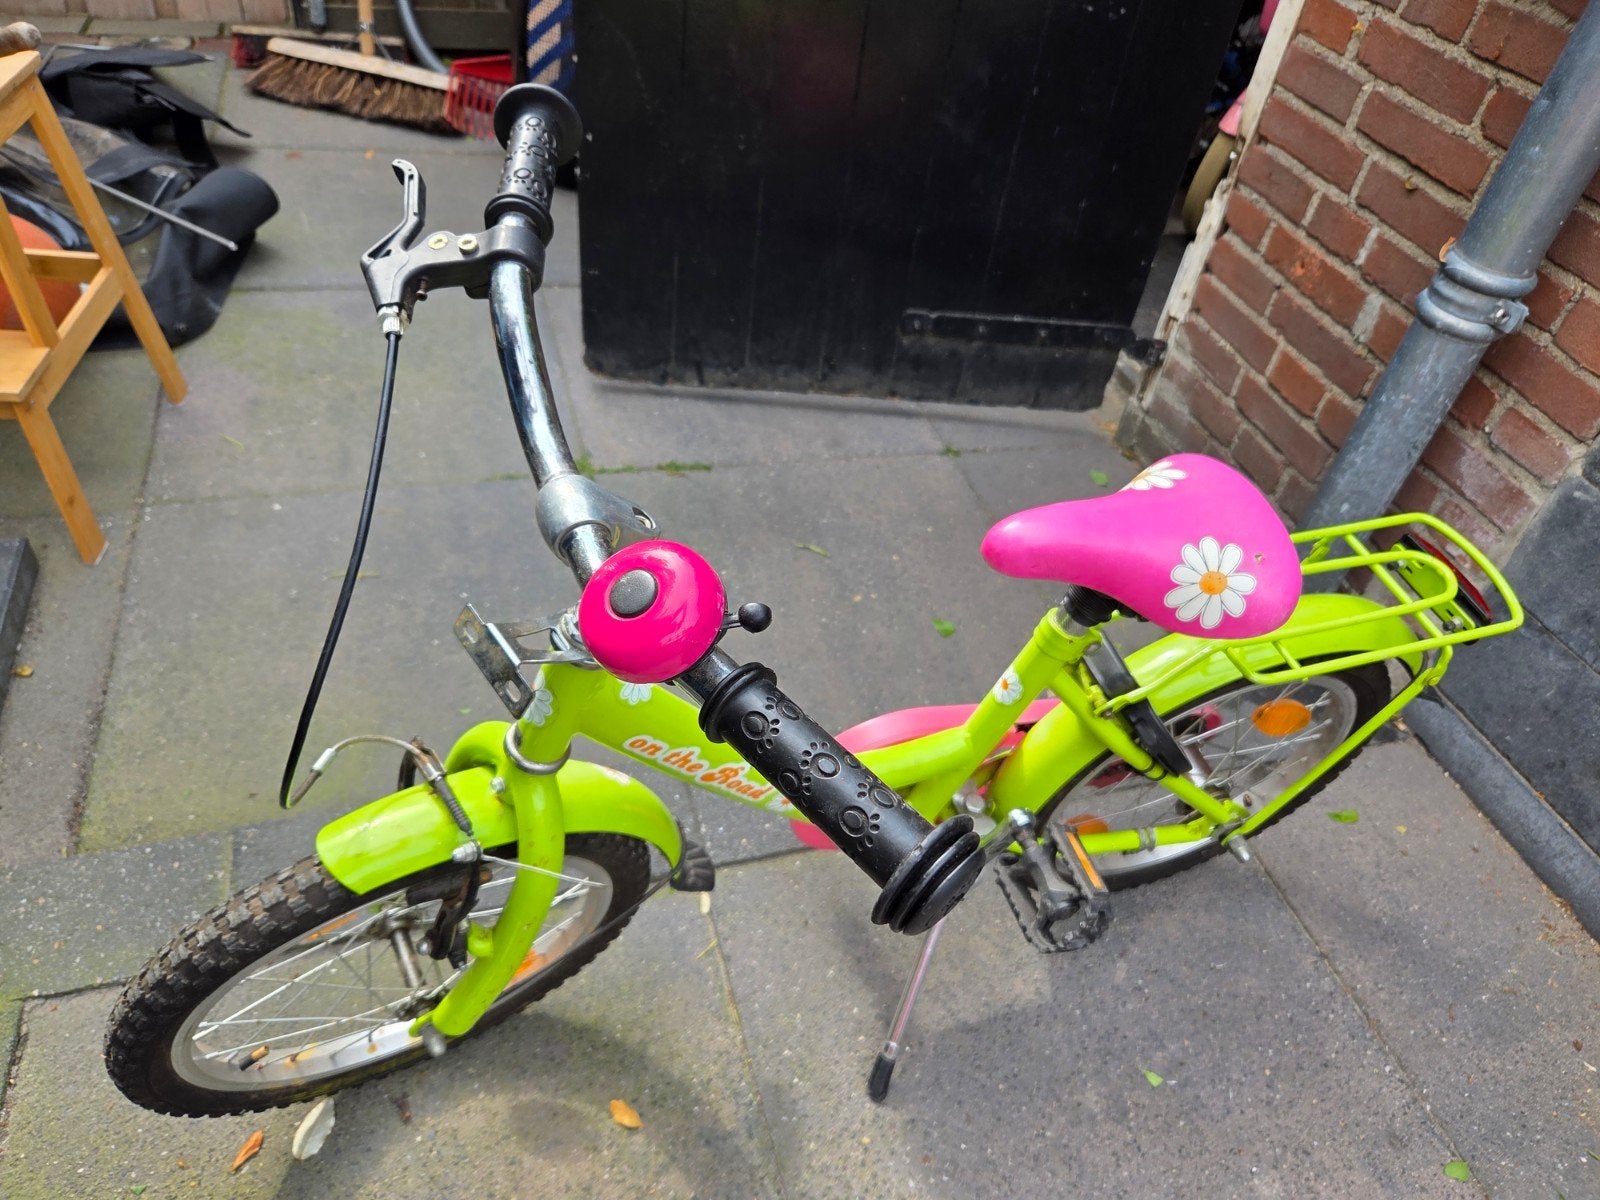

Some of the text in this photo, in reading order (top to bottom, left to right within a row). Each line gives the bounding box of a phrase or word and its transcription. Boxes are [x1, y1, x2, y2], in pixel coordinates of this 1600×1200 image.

[628, 738, 773, 799] on the Road
